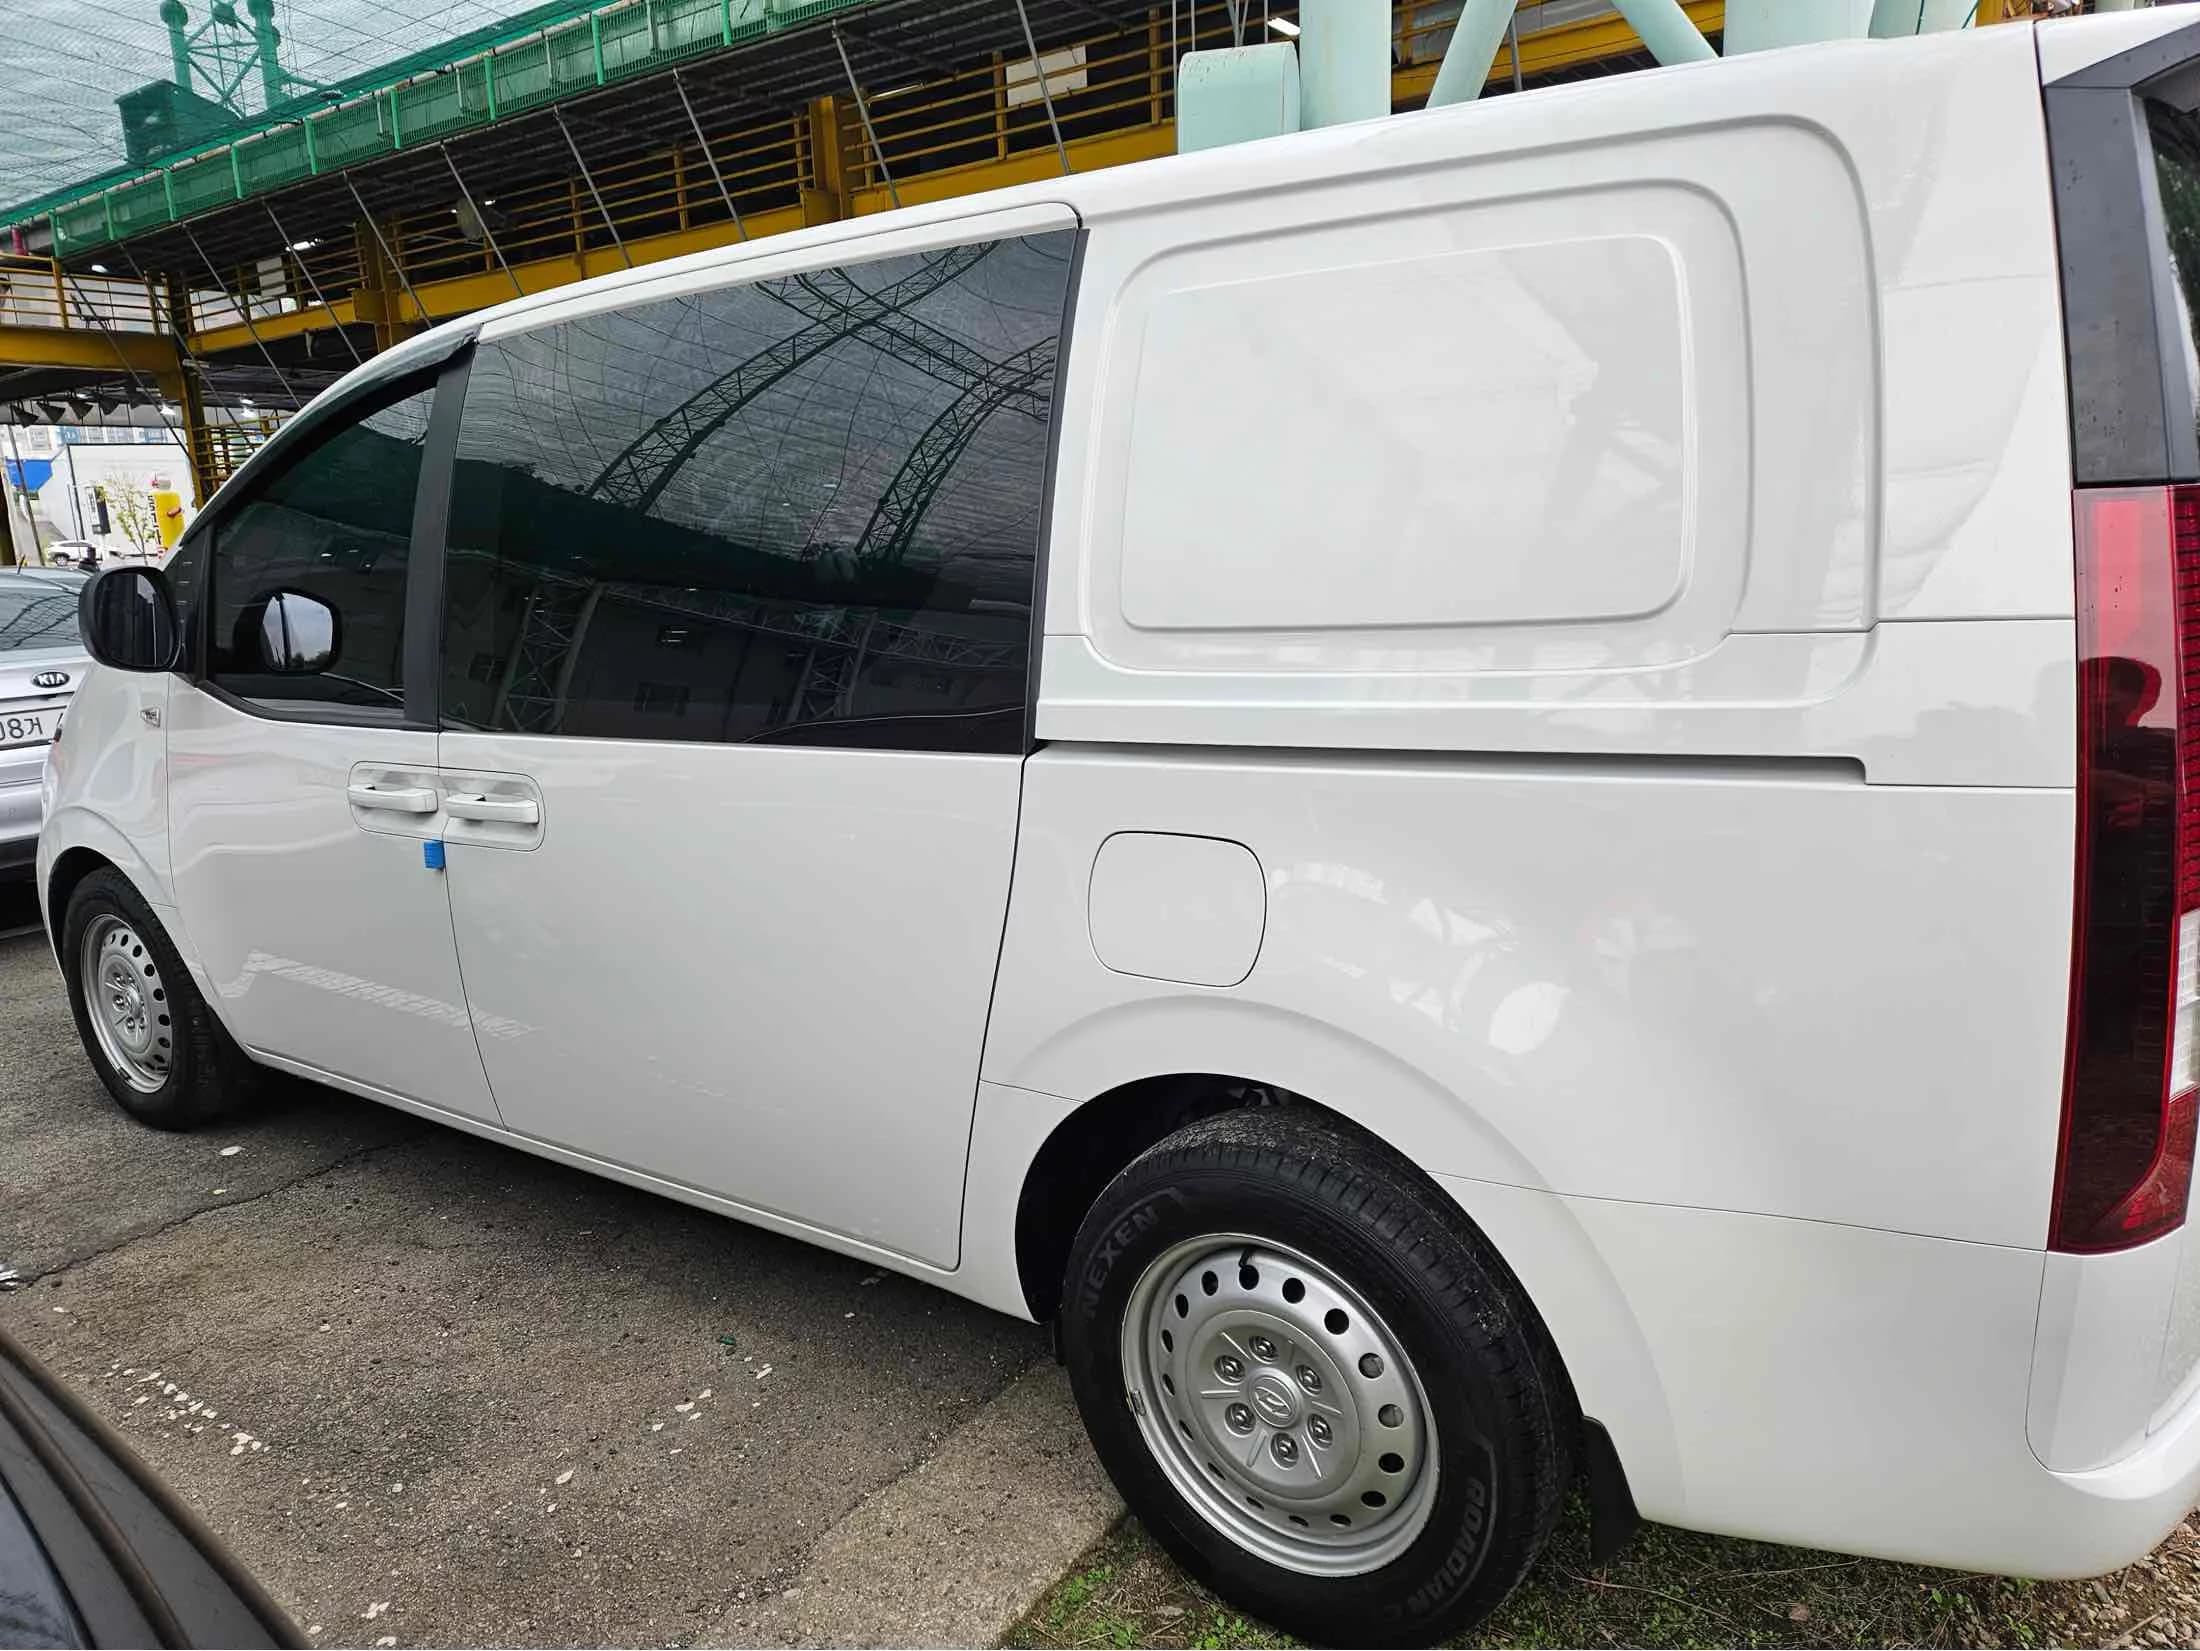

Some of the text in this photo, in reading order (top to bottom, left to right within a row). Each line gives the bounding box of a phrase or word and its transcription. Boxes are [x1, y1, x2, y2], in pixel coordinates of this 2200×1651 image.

[36, 672, 68, 687] KIA
[1081, 1206, 1160, 1320] NEXEN
[1408, 1476, 1486, 1614] ROADIAN
